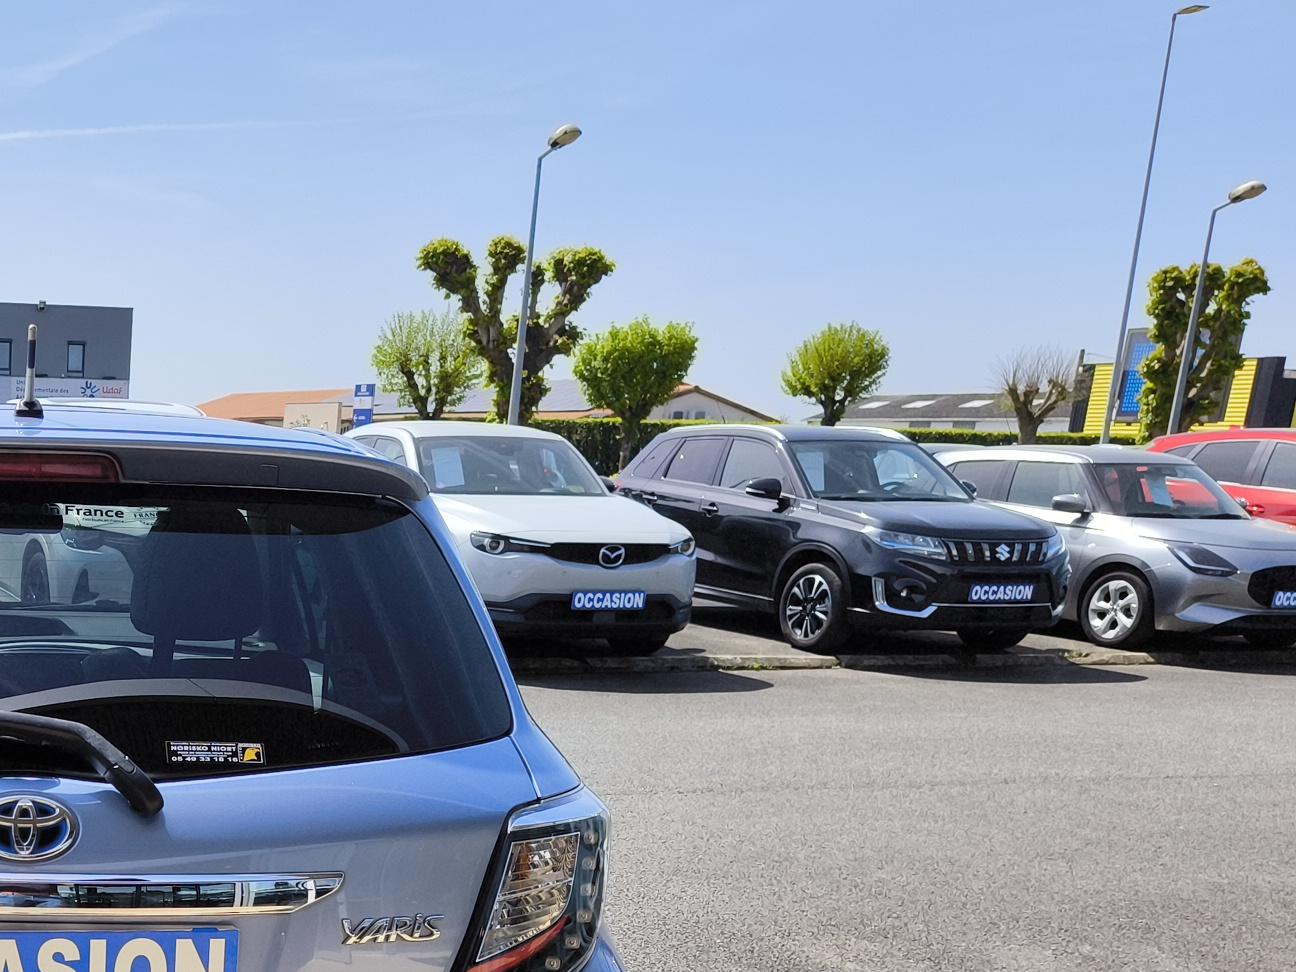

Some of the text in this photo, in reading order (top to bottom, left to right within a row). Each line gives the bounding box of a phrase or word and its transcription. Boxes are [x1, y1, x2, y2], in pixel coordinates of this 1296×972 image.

[65, 505, 124, 519] France
[574, 592, 644, 608] OCCASION
[971, 585, 1034, 600] OCCASION
